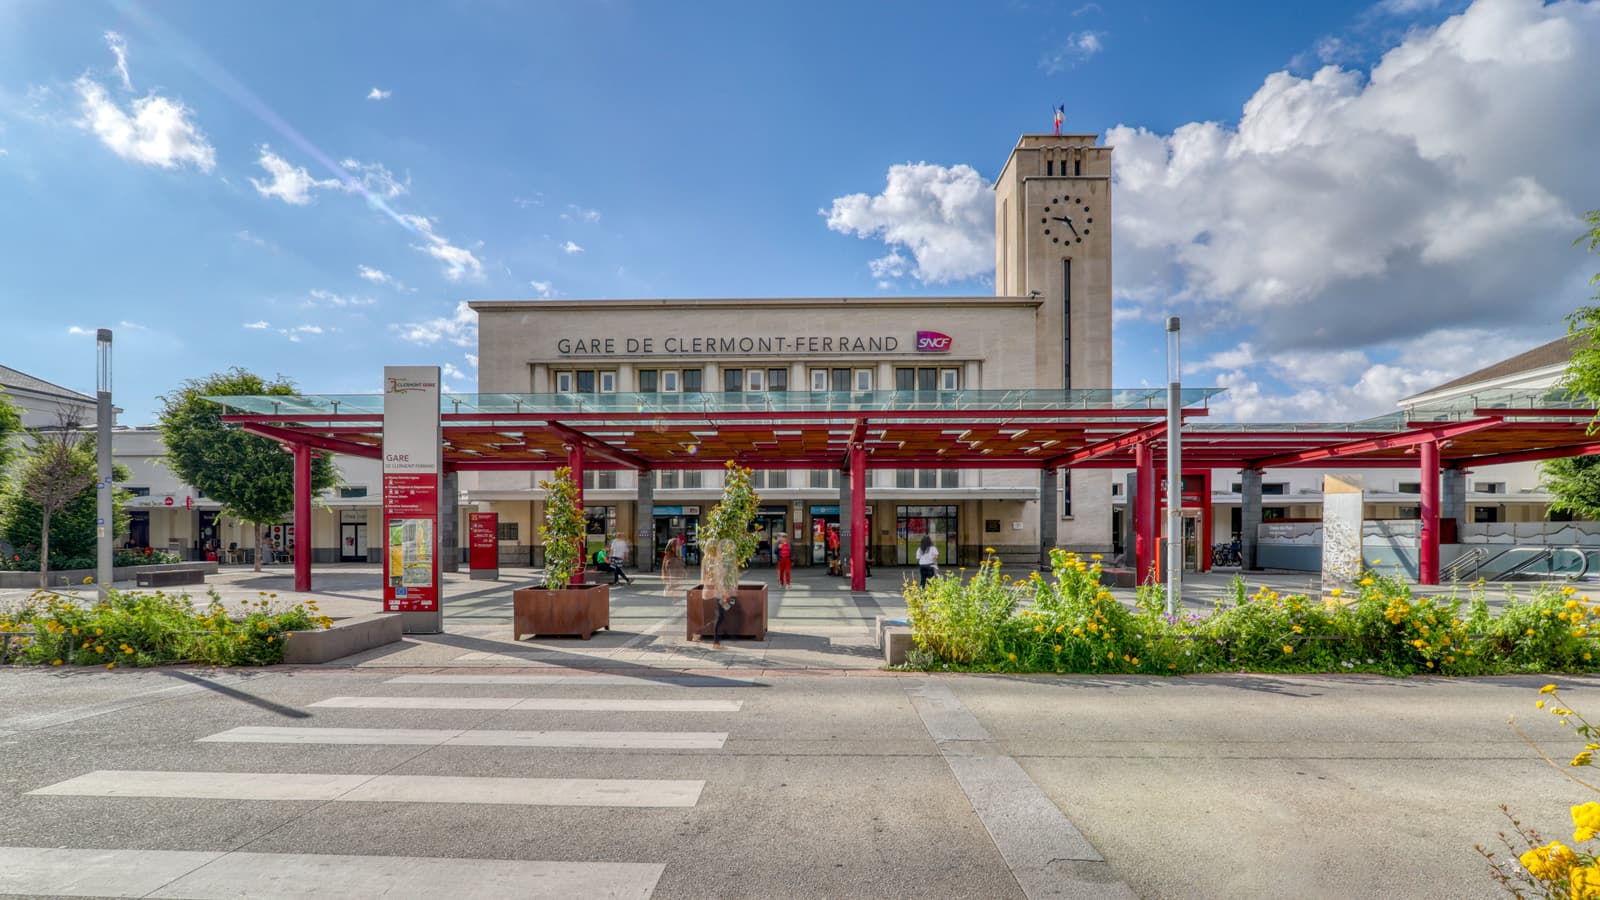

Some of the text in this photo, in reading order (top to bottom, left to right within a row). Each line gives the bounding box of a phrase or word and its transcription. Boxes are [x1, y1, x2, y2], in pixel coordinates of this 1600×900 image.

[557, 336, 899, 354] GARE DE CLERMONT-FERRAND
[918, 337, 950, 348] SNCF
[386, 454, 409, 462] GARE
